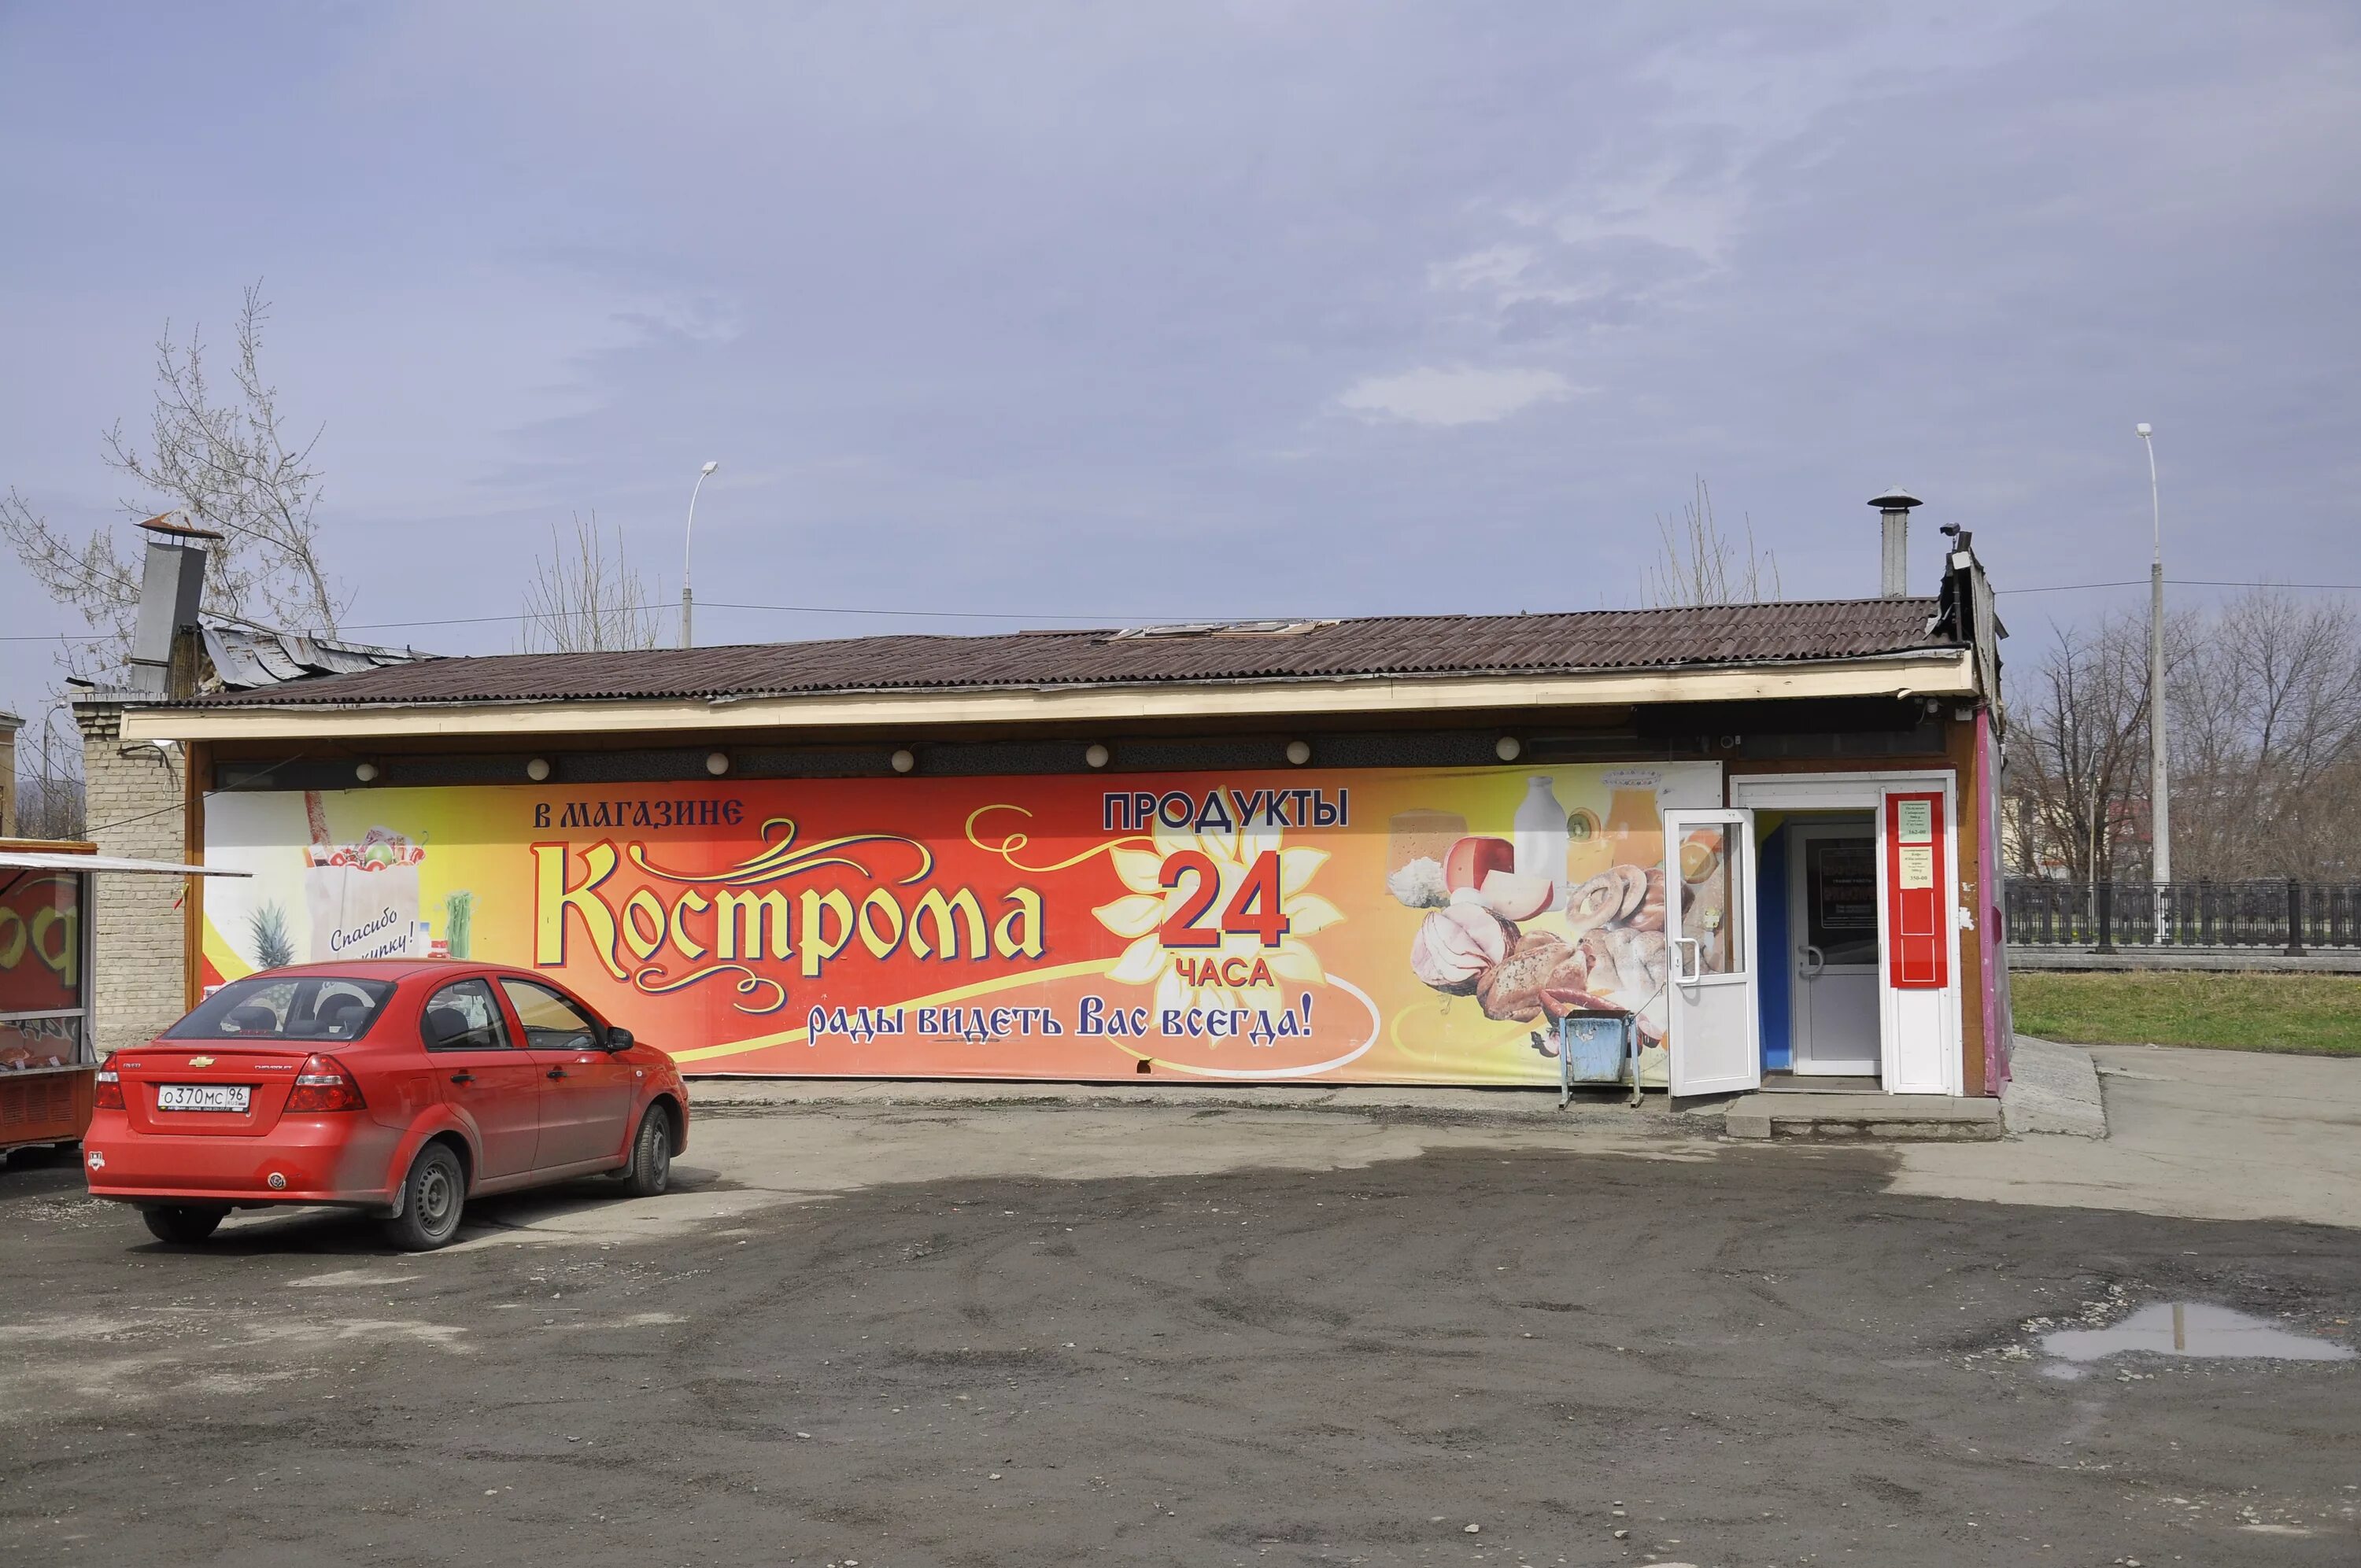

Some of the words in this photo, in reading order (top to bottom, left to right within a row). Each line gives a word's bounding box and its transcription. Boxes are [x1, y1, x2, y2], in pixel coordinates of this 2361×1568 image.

[1103, 788, 1349, 834] ПРОДУКТЫ
[532, 843, 1046, 982] Кострома
[1158, 850, 1291, 949] 24
[331, 906, 397, 952] Спасибо
[1176, 957, 1274, 987] ЧАСА
[808, 1005, 906, 1047] рады
[917, 1006, 1063, 1046] видеть
[1075, 995, 1150, 1038] Вас
[1161, 993, 1314, 1046] всегда!
[229, 1088, 243, 1101] 96
